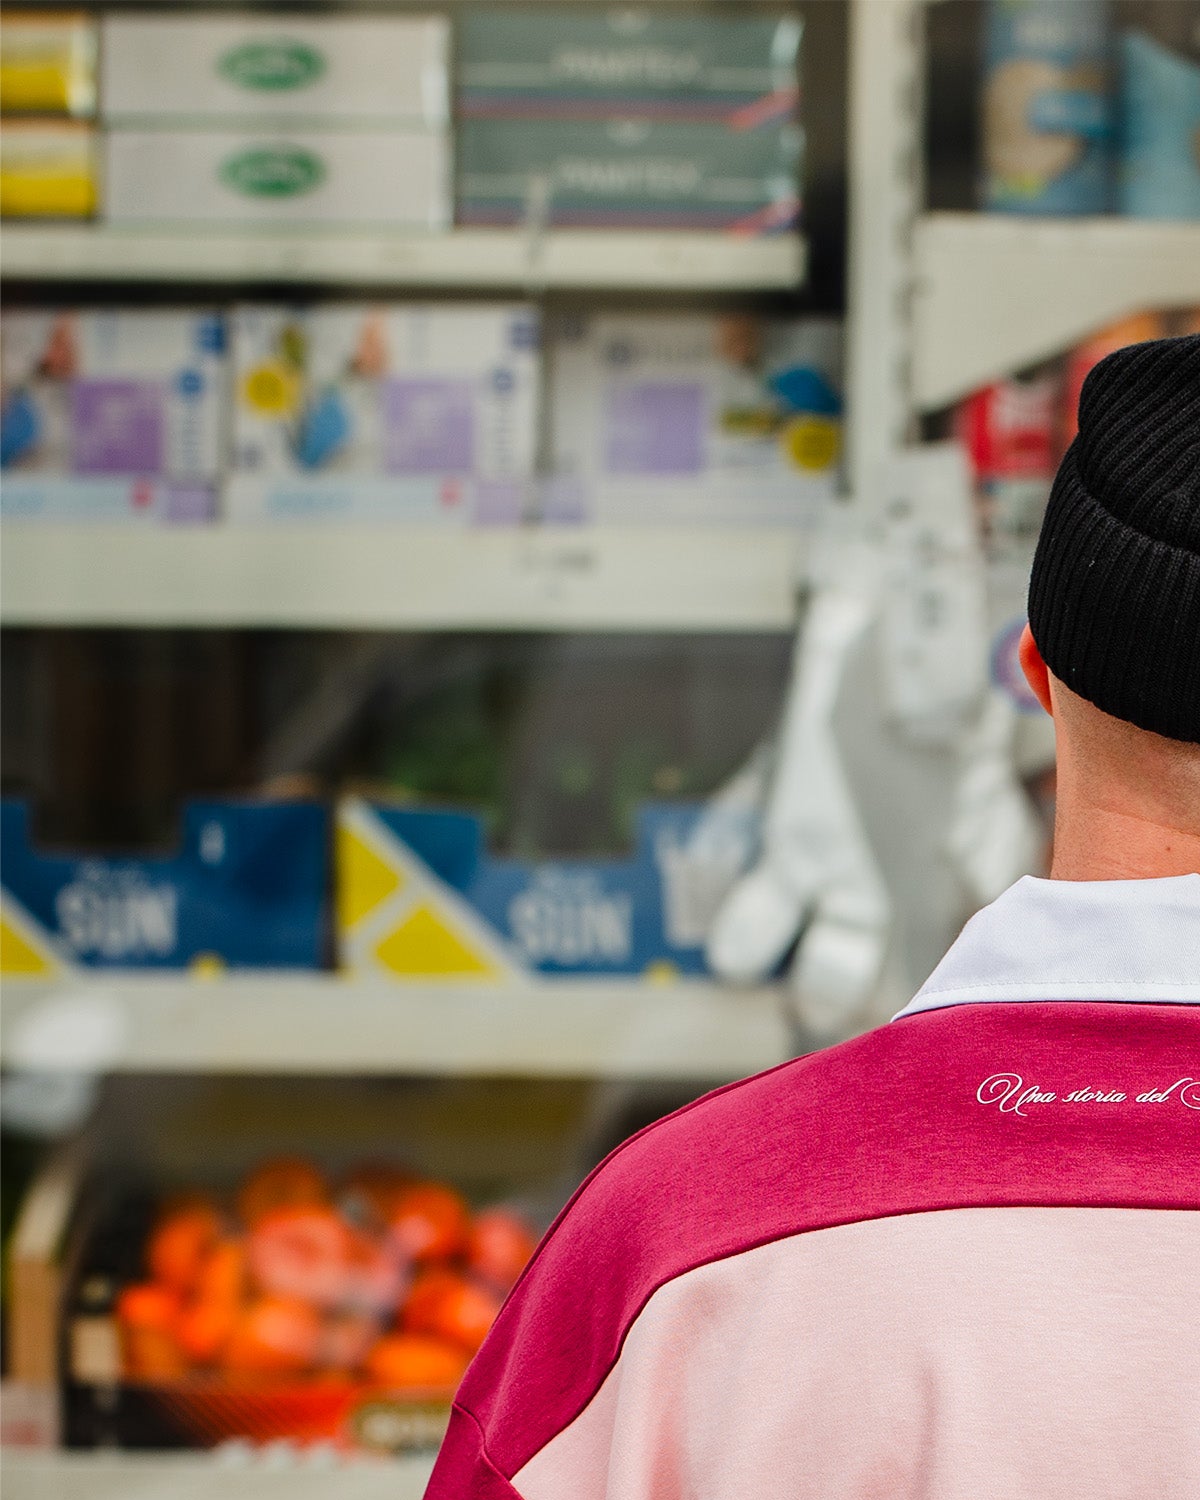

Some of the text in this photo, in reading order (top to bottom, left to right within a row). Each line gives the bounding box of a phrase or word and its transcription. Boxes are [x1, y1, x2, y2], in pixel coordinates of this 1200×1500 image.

[976, 1072, 1057, 1117] Una
[1061, 1086, 1128, 1103] storia
[1135, 1077, 1194, 1103] del
